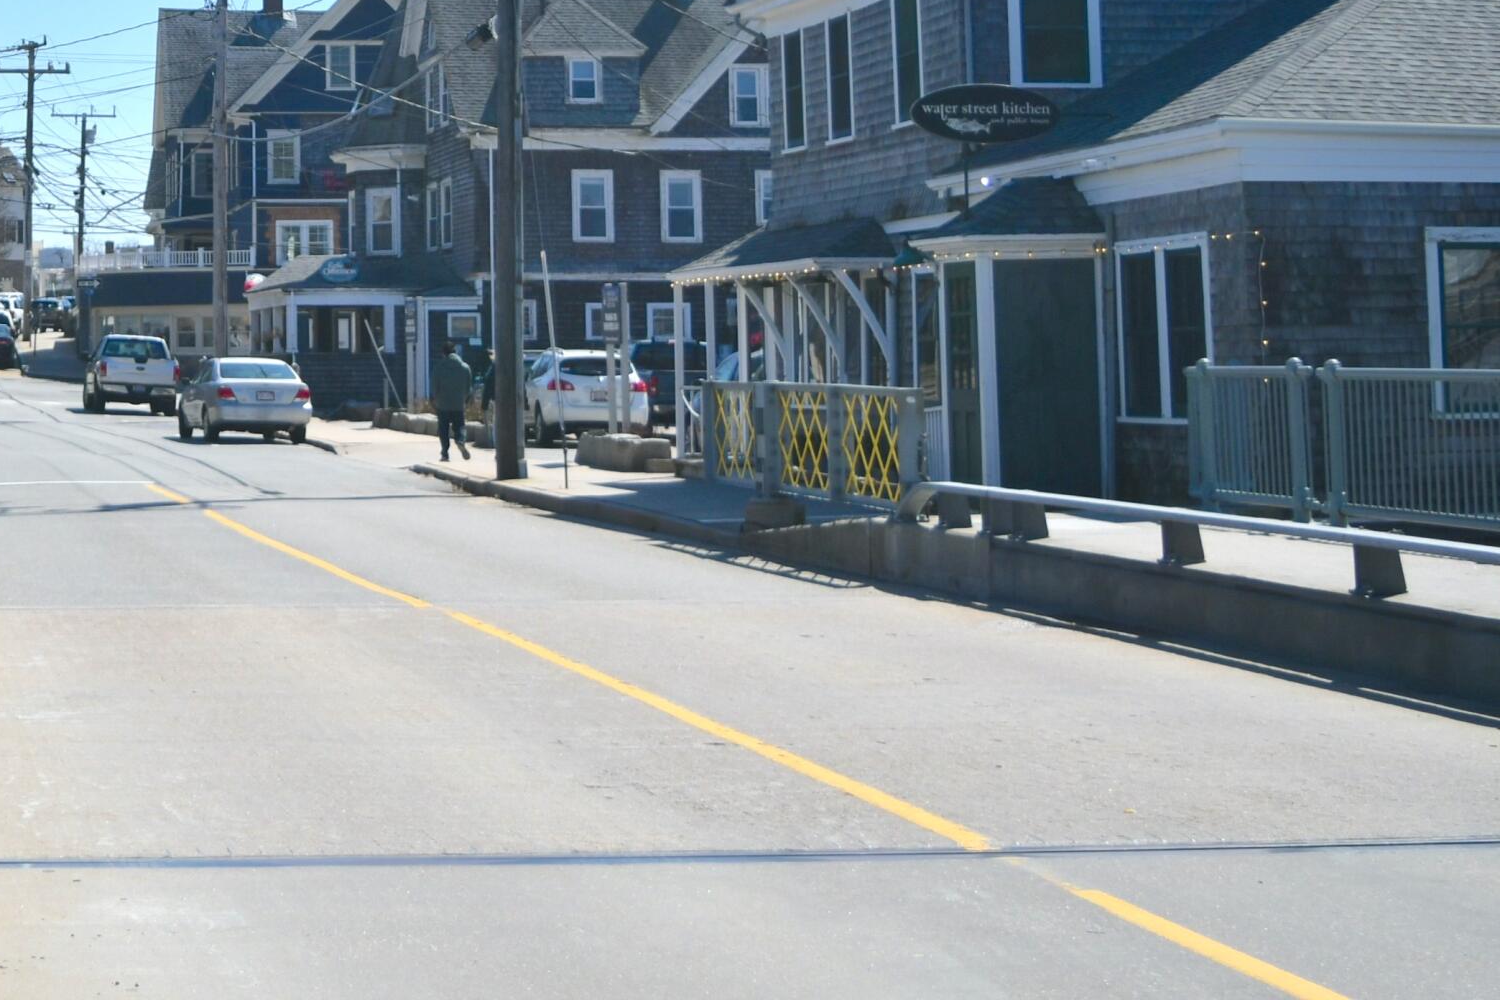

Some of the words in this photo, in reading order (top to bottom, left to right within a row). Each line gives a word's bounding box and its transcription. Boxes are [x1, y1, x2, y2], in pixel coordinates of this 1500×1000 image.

[922, 103, 958, 120] water
[961, 104, 997, 114] street
[1002, 101, 1050, 114] kitchen
